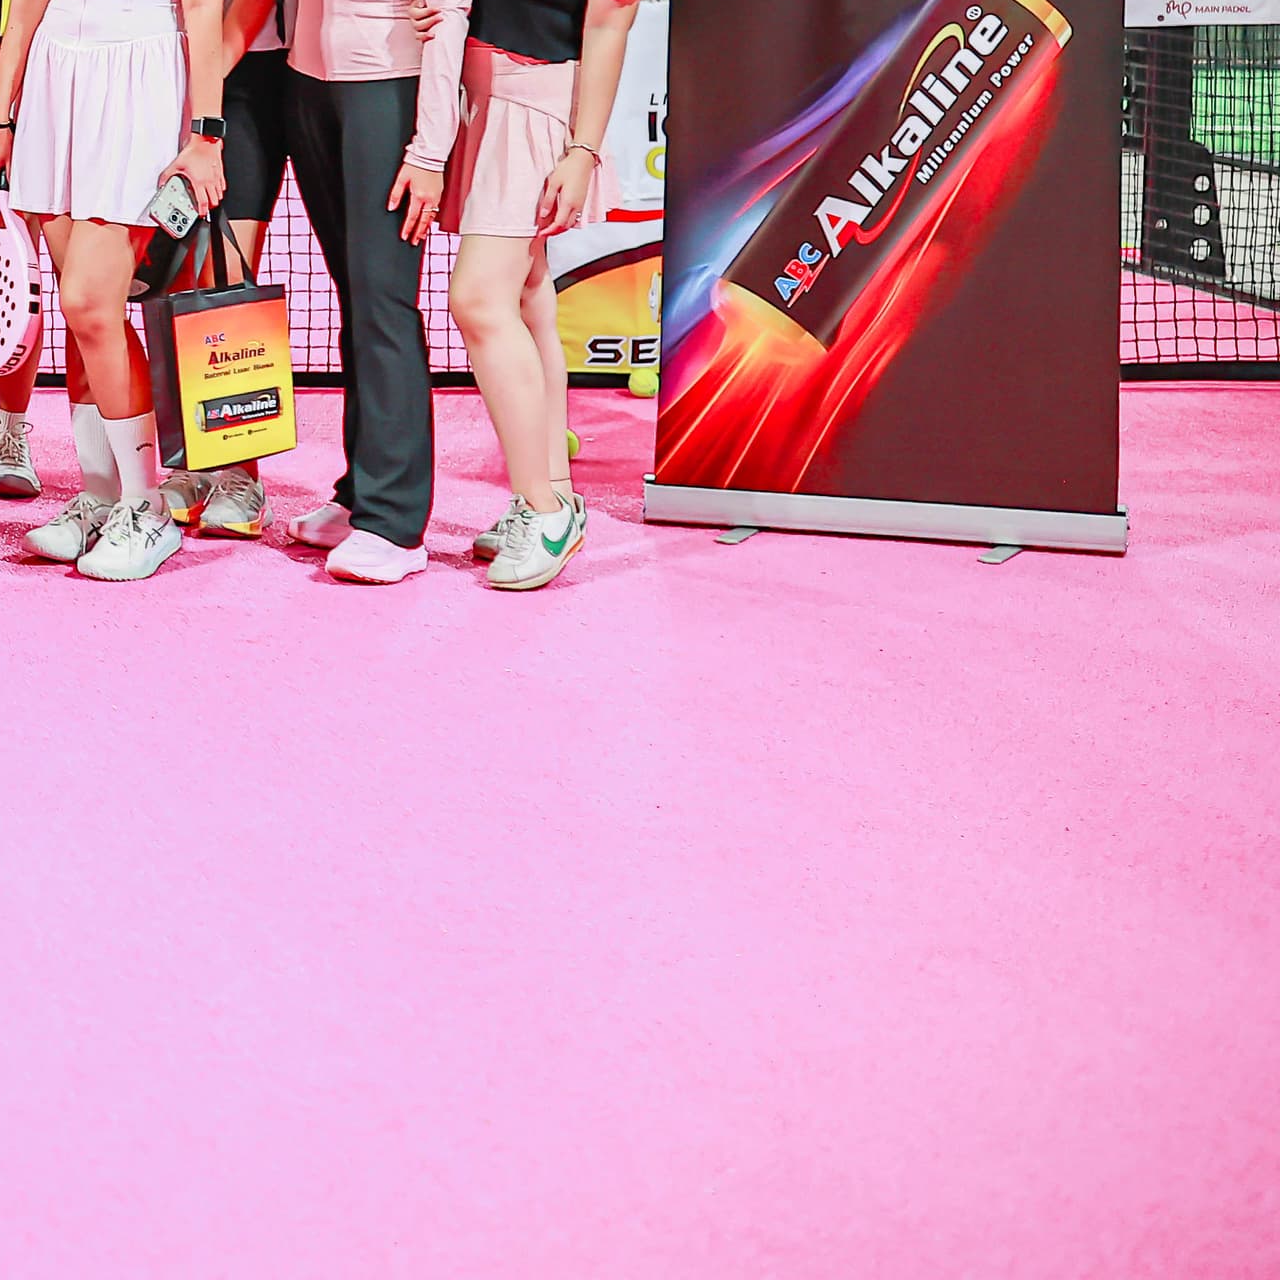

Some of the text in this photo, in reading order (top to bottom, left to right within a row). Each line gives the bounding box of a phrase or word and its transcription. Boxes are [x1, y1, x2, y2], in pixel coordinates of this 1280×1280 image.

[1195, 5, 1219, 14] MAIN
[916, 32, 1035, 185] Millennium Power
[774, 12, 1009, 303] ABC Alkaline
[204, 332, 226, 345] ABC
[207, 347, 266, 366] Alkaline
[219, 398, 277, 418] Alkaline
